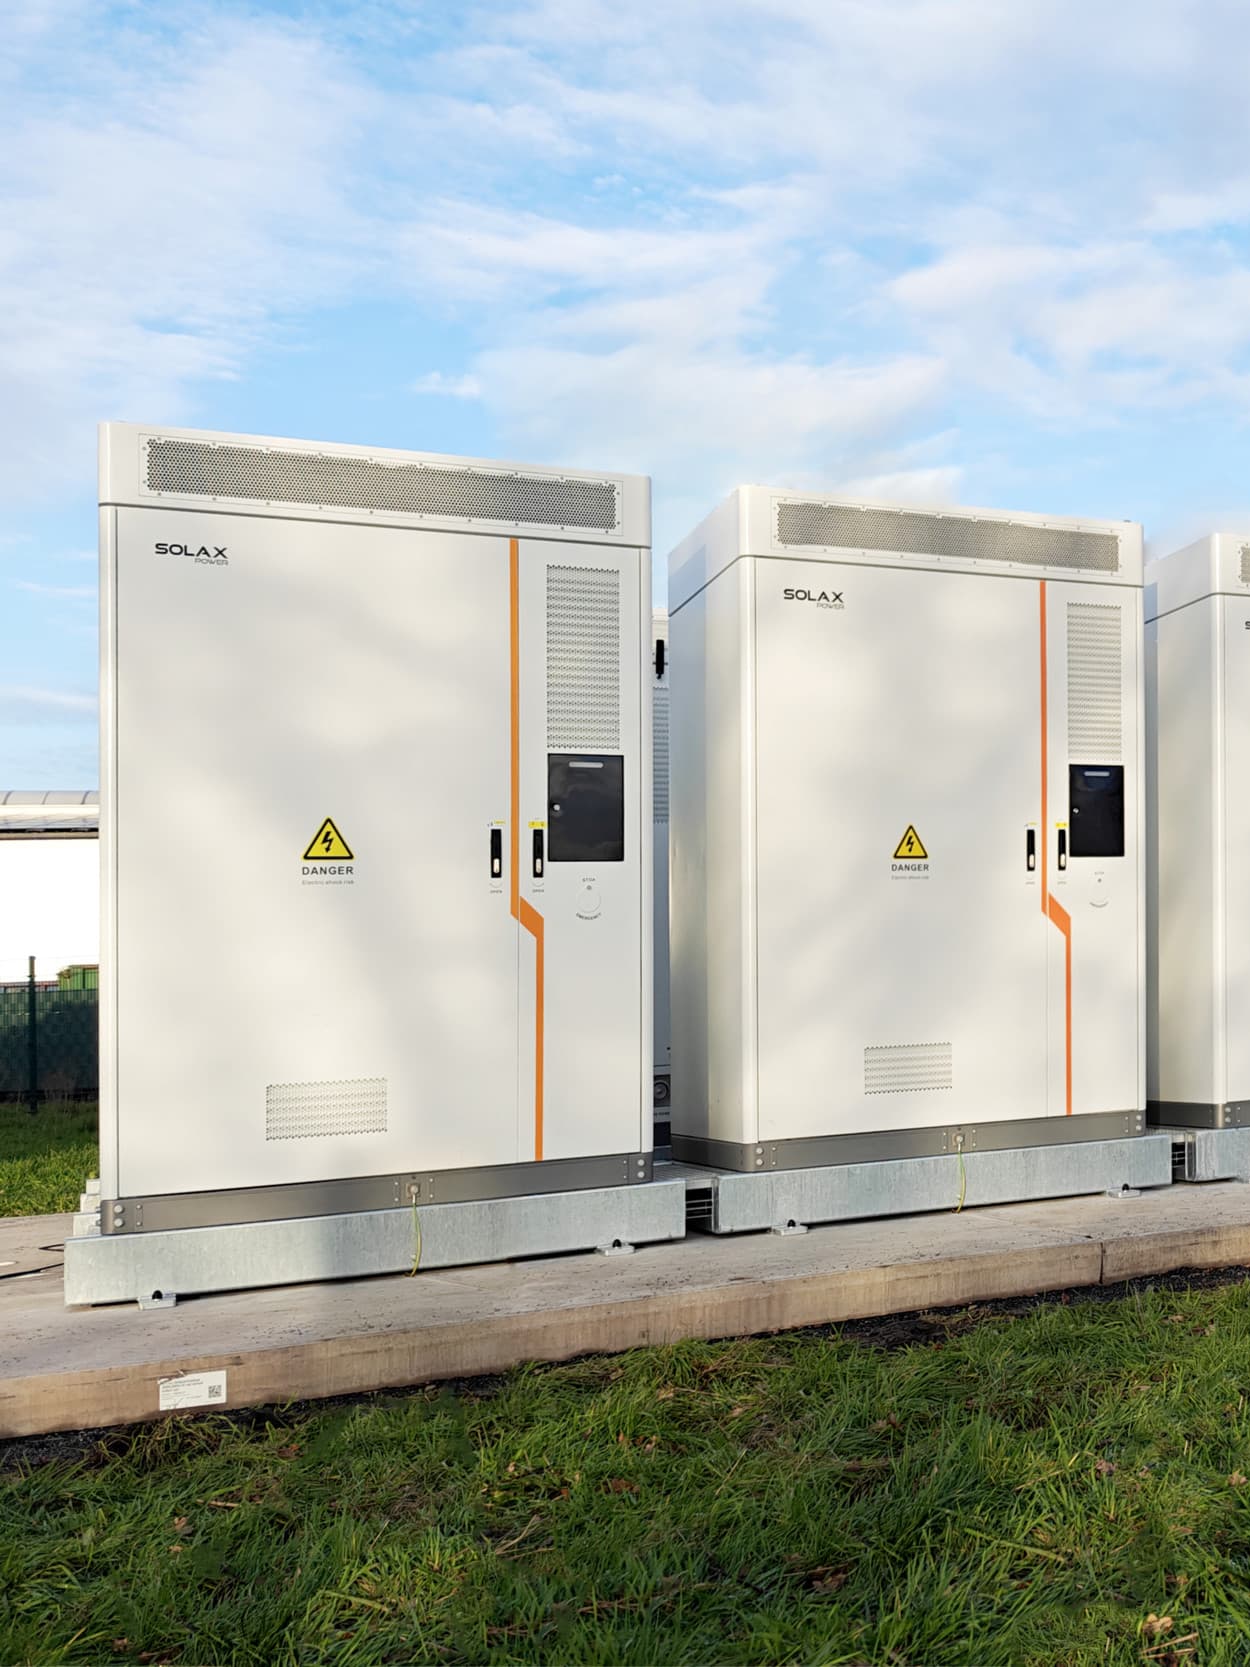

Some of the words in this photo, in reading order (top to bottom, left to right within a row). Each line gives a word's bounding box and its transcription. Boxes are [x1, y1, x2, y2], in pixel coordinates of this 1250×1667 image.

[155, 542, 229, 559] SOLAX
[194, 557, 229, 566] POWER
[783, 588, 844, 604] SOLAX
[816, 602, 845, 611] POWER
[302, 866, 354, 875] DANGER
